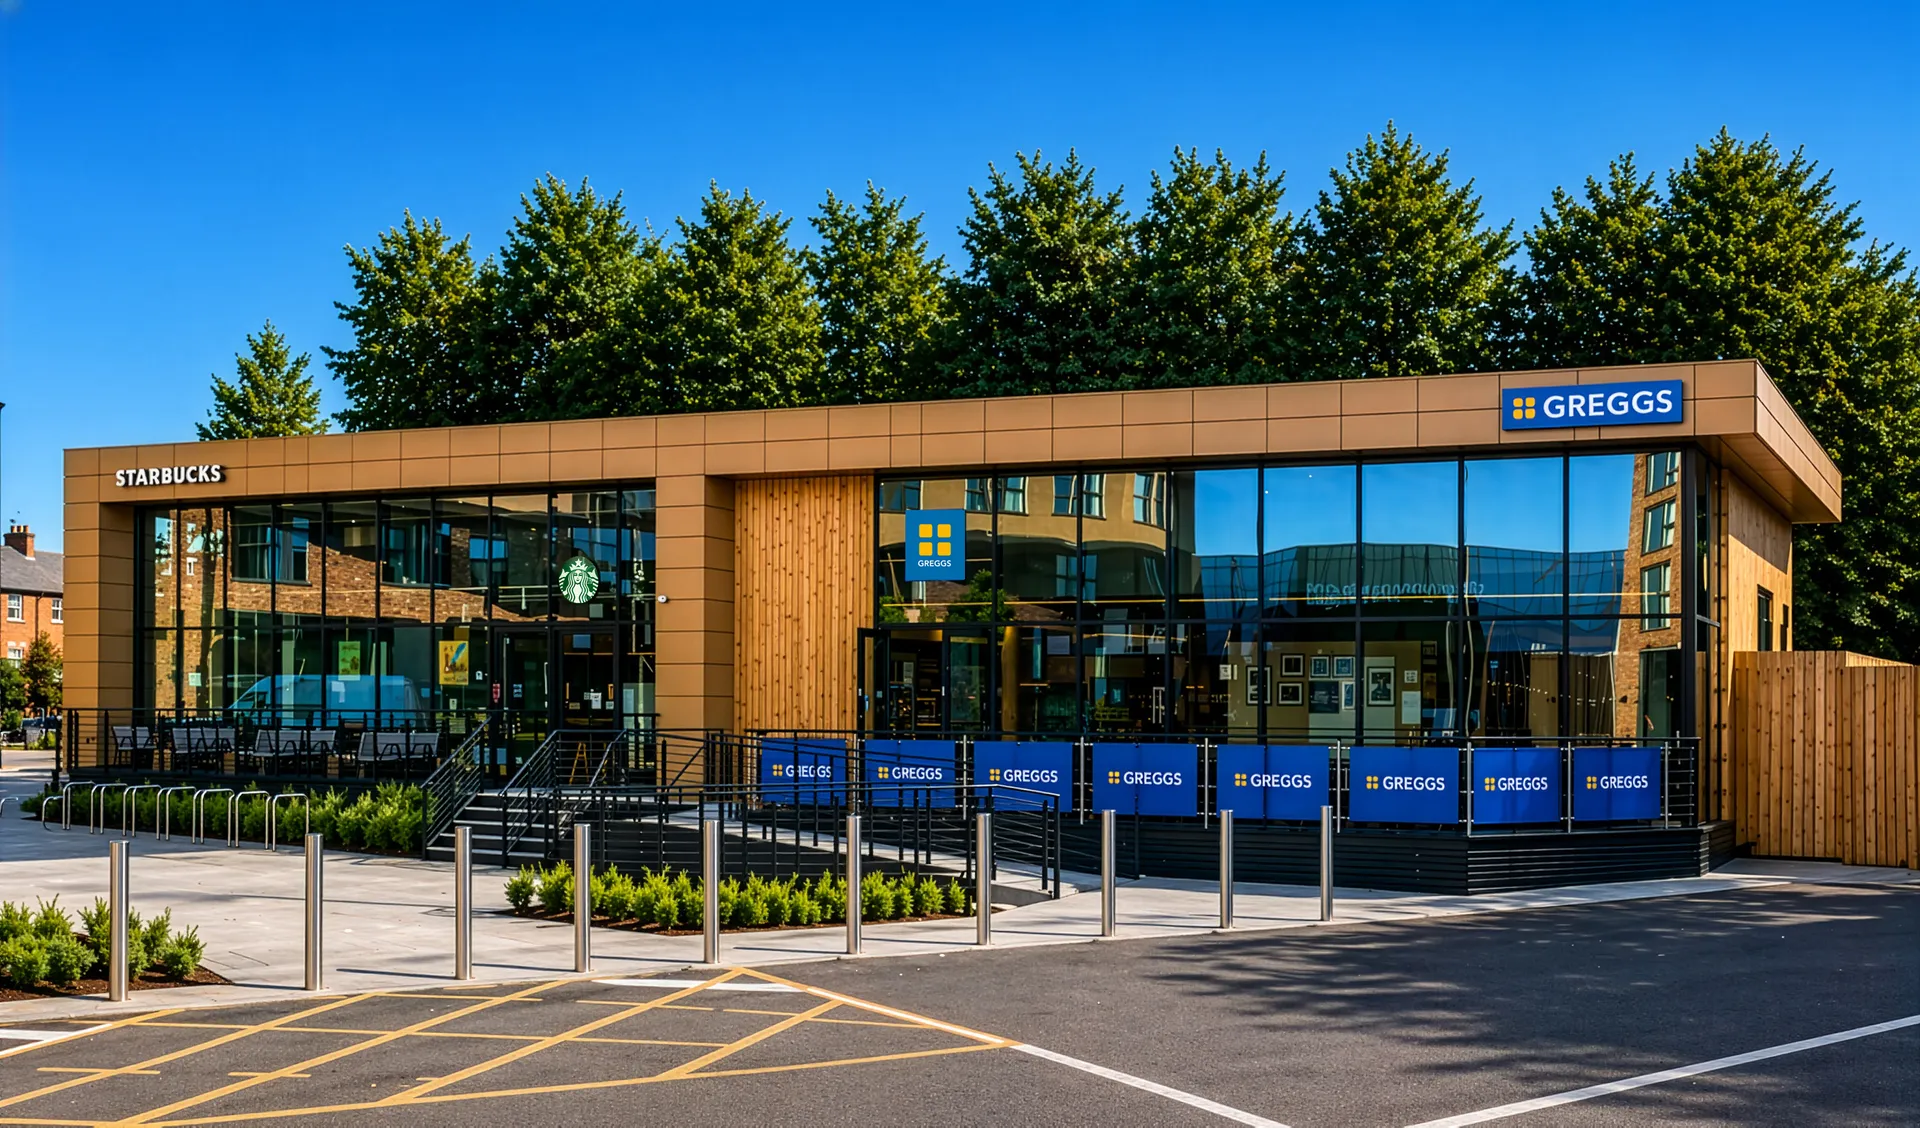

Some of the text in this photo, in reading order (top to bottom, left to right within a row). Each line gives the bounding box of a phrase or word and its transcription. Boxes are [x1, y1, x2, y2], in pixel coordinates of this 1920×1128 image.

[1543, 389, 1673, 419] GREGGS
[115, 464, 222, 487] STARBUCKS
[917, 559, 952, 568] GREGGS
[891, 766, 943, 780] GREGGS
[1003, 768, 1058, 783] GREGGS
[1123, 771, 1182, 786] GREGGS
[1250, 773, 1312, 789] GREGGS
[1382, 775, 1445, 791] GREGGS
[1497, 776, 1548, 791] GREGGS
[1600, 775, 1648, 789] GREGGS
